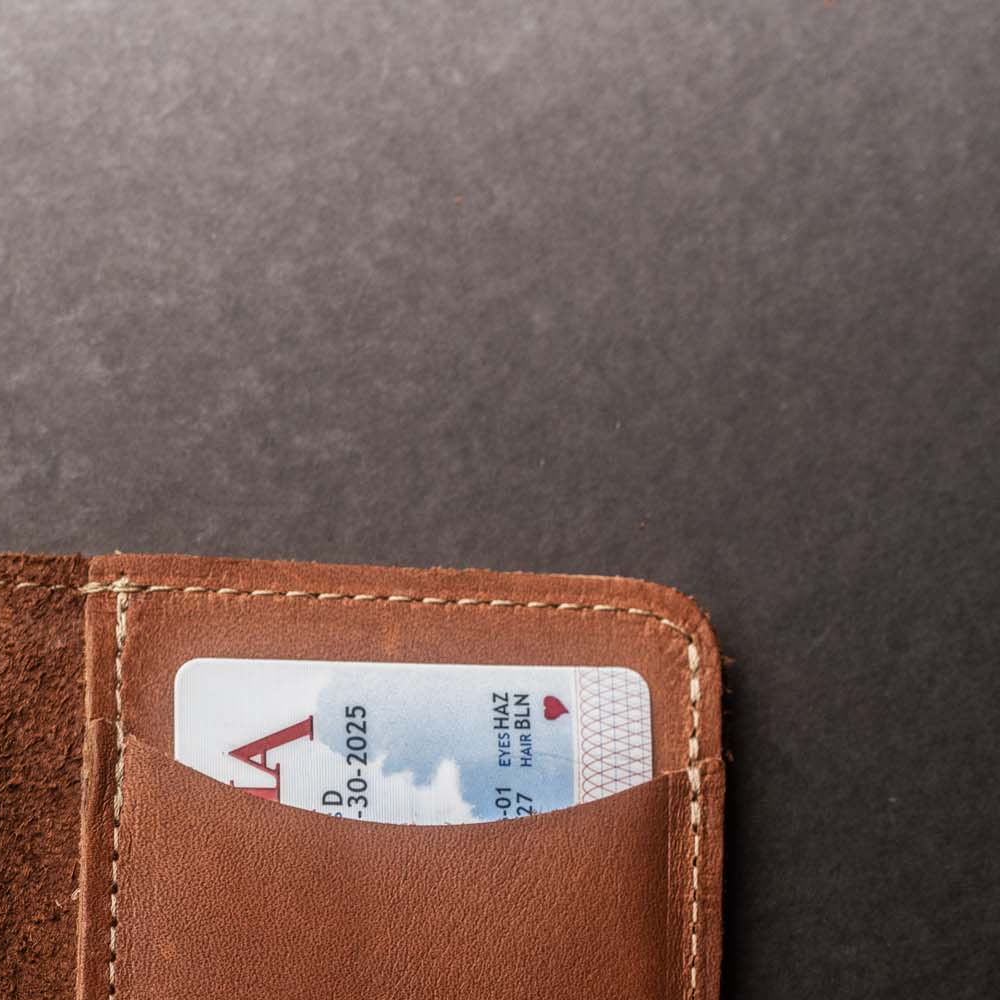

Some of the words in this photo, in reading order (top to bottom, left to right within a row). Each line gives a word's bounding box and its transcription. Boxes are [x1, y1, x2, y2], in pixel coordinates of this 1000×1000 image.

[492, 692, 509, 729] HAZ
[513, 694, 530, 729] BLN
[229, 715, 314, 803] A
[498, 732, 511, 767] EYES
[519, 733, 532, 767] HAIR
